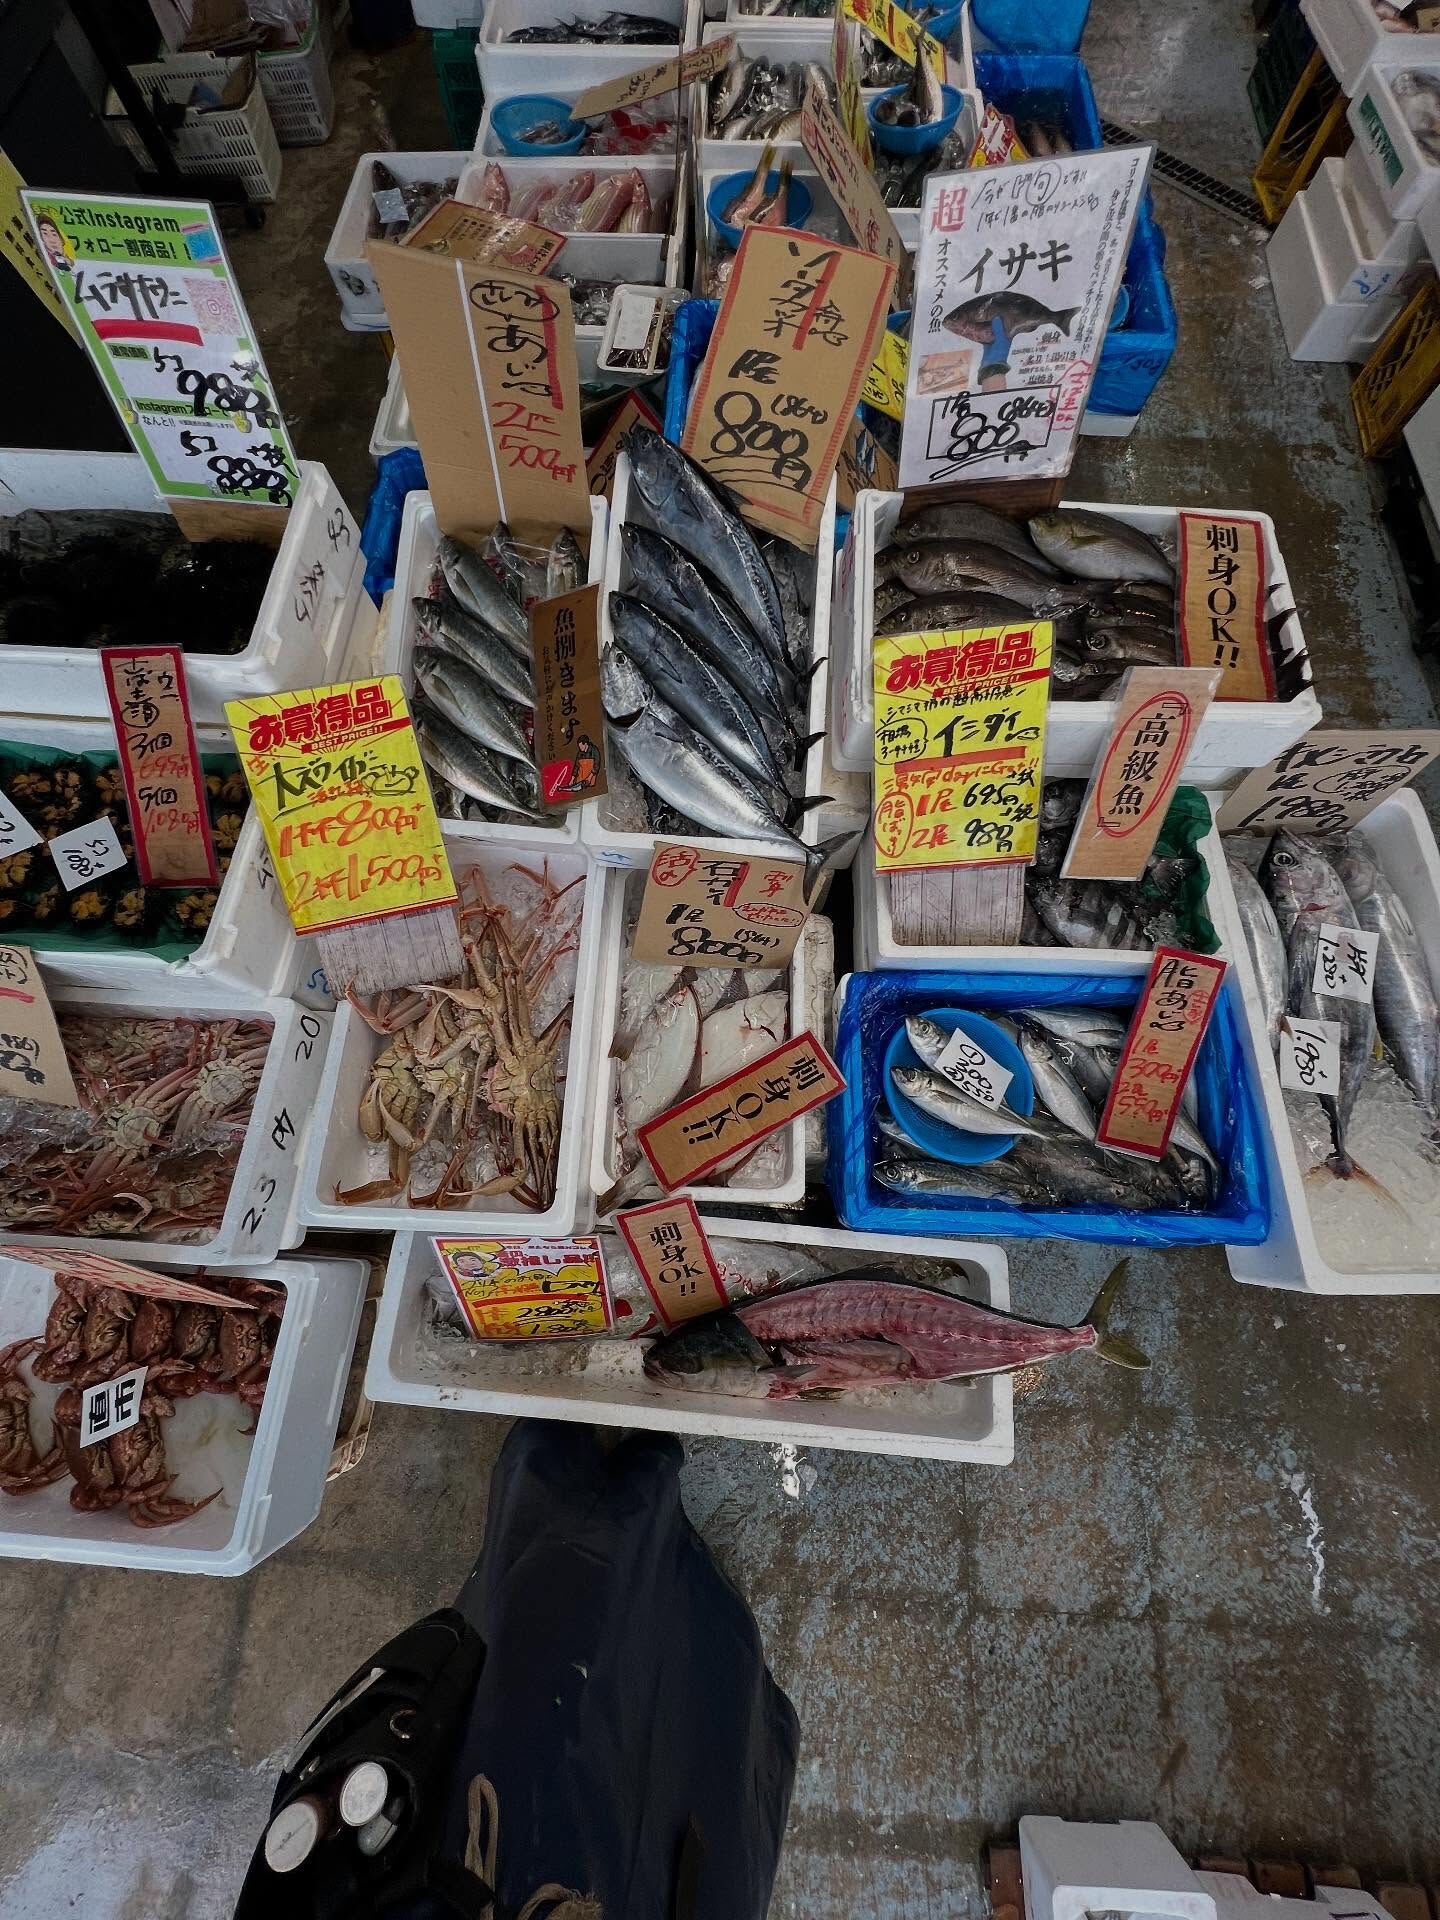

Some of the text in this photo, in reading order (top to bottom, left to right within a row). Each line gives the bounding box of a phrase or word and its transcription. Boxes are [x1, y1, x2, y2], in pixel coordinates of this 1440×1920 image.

[59, 205, 181, 235] 公式Instagram
[928, 187, 968, 333] 超 オススメの魚
[958, 239, 1073, 294] イサキ
[1204, 523, 1240, 669] 刺身OK!!
[886, 629, 1037, 694] お買得品
[944, 683, 971, 695] BEST
[248, 684, 393, 753] お買得品
[311, 736, 340, 751] BEST
[681, 1051, 826, 1146] 刺身OK!!
